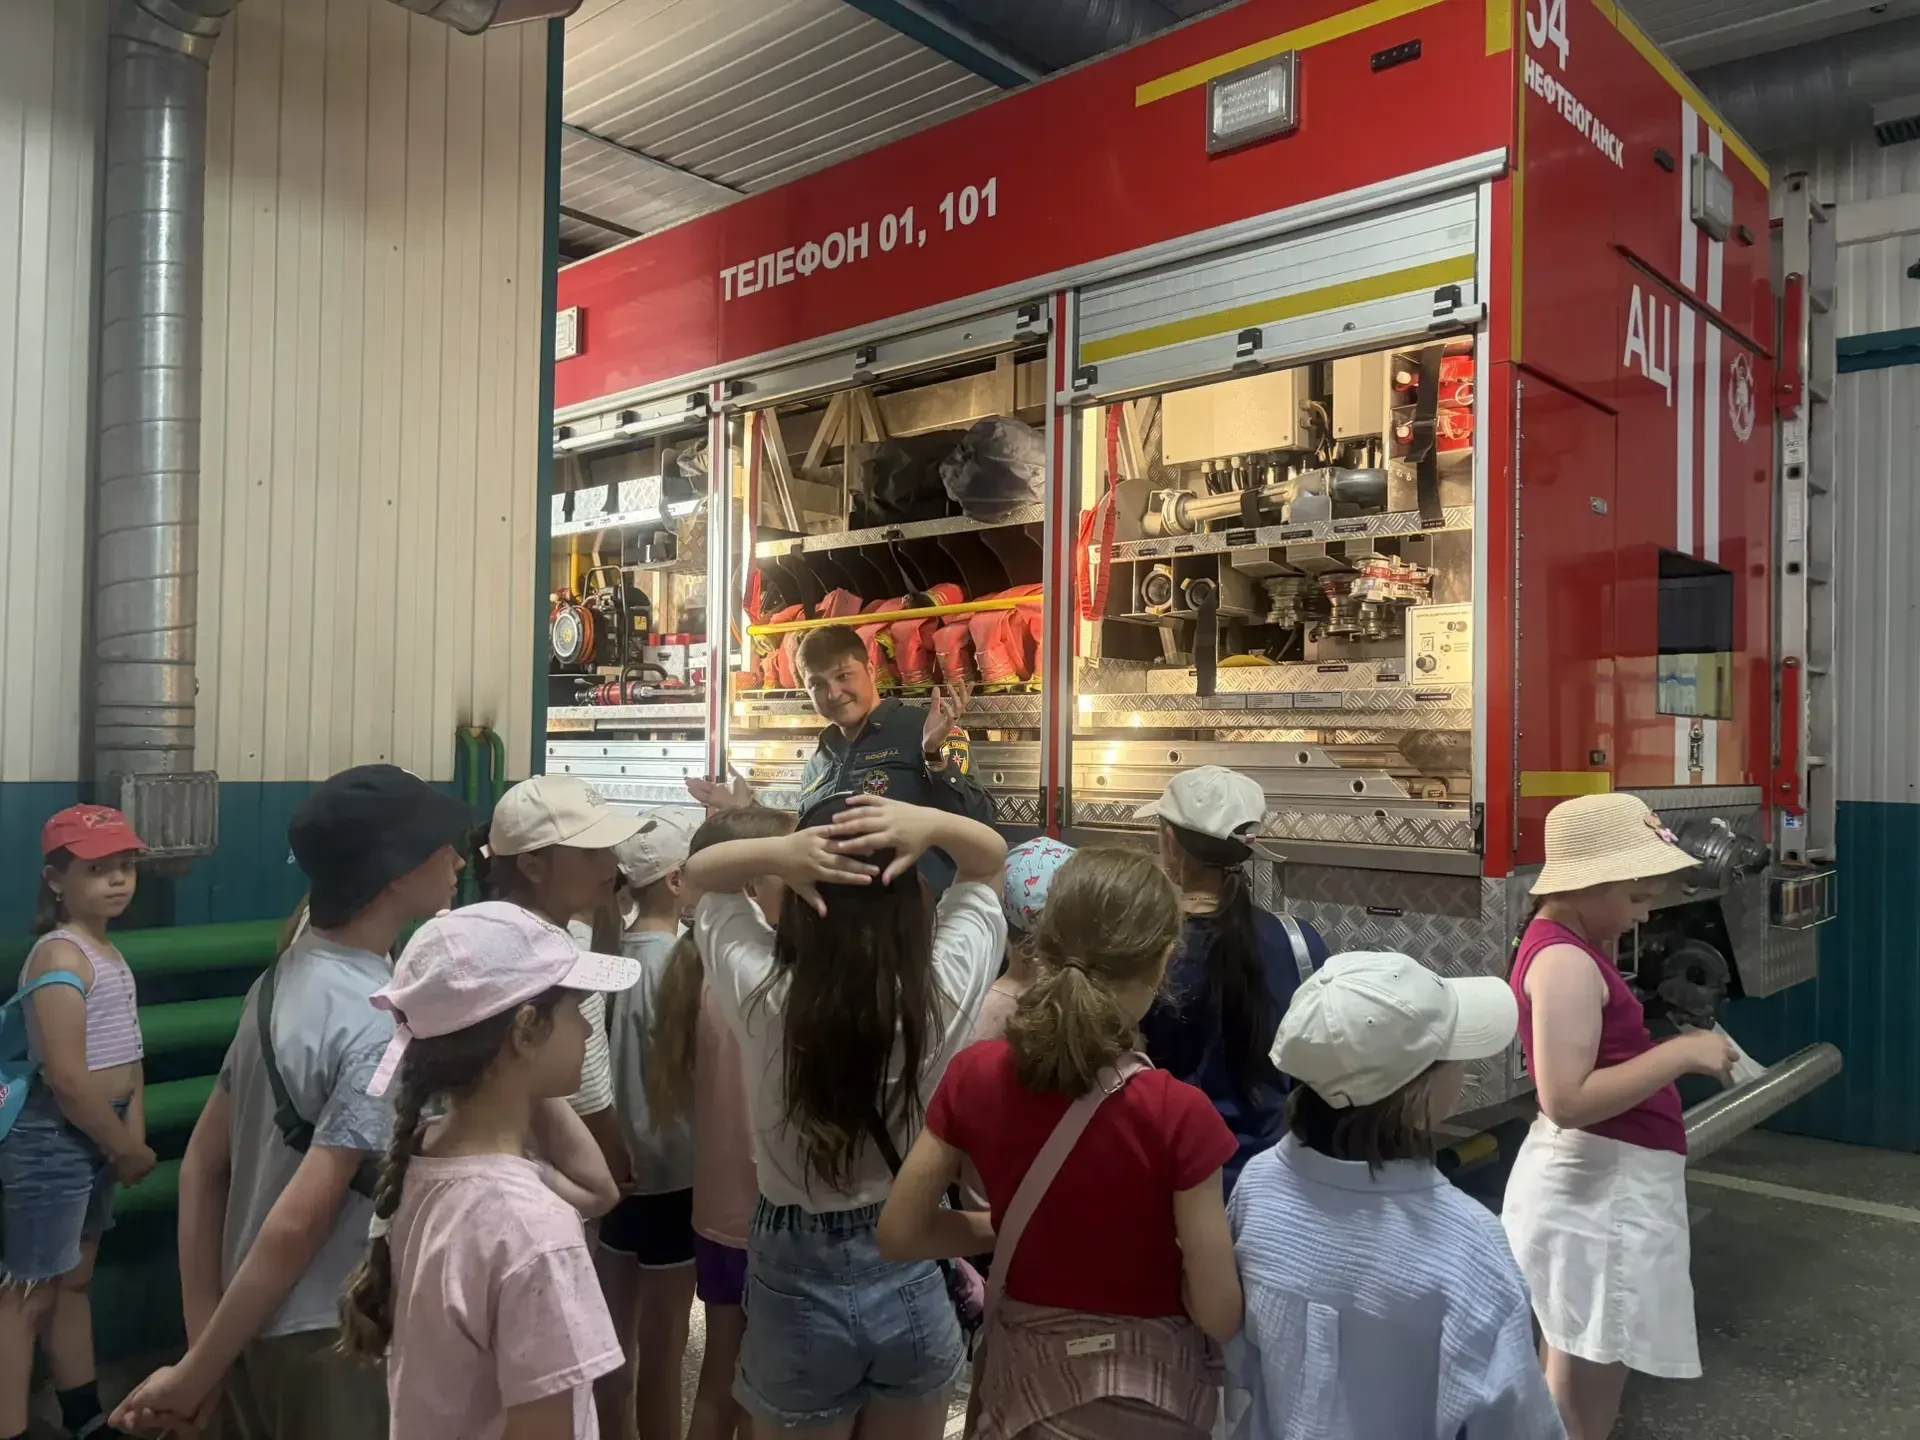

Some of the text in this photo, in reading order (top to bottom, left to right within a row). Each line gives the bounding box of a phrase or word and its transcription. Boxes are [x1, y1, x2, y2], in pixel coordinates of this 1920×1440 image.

[1524, 54, 1625, 169] НЕФТЕЮГАНСК
[720, 177, 998, 301] ТЕЛЕФОН 01, 101
[1623, 284, 1672, 408] АЦ
